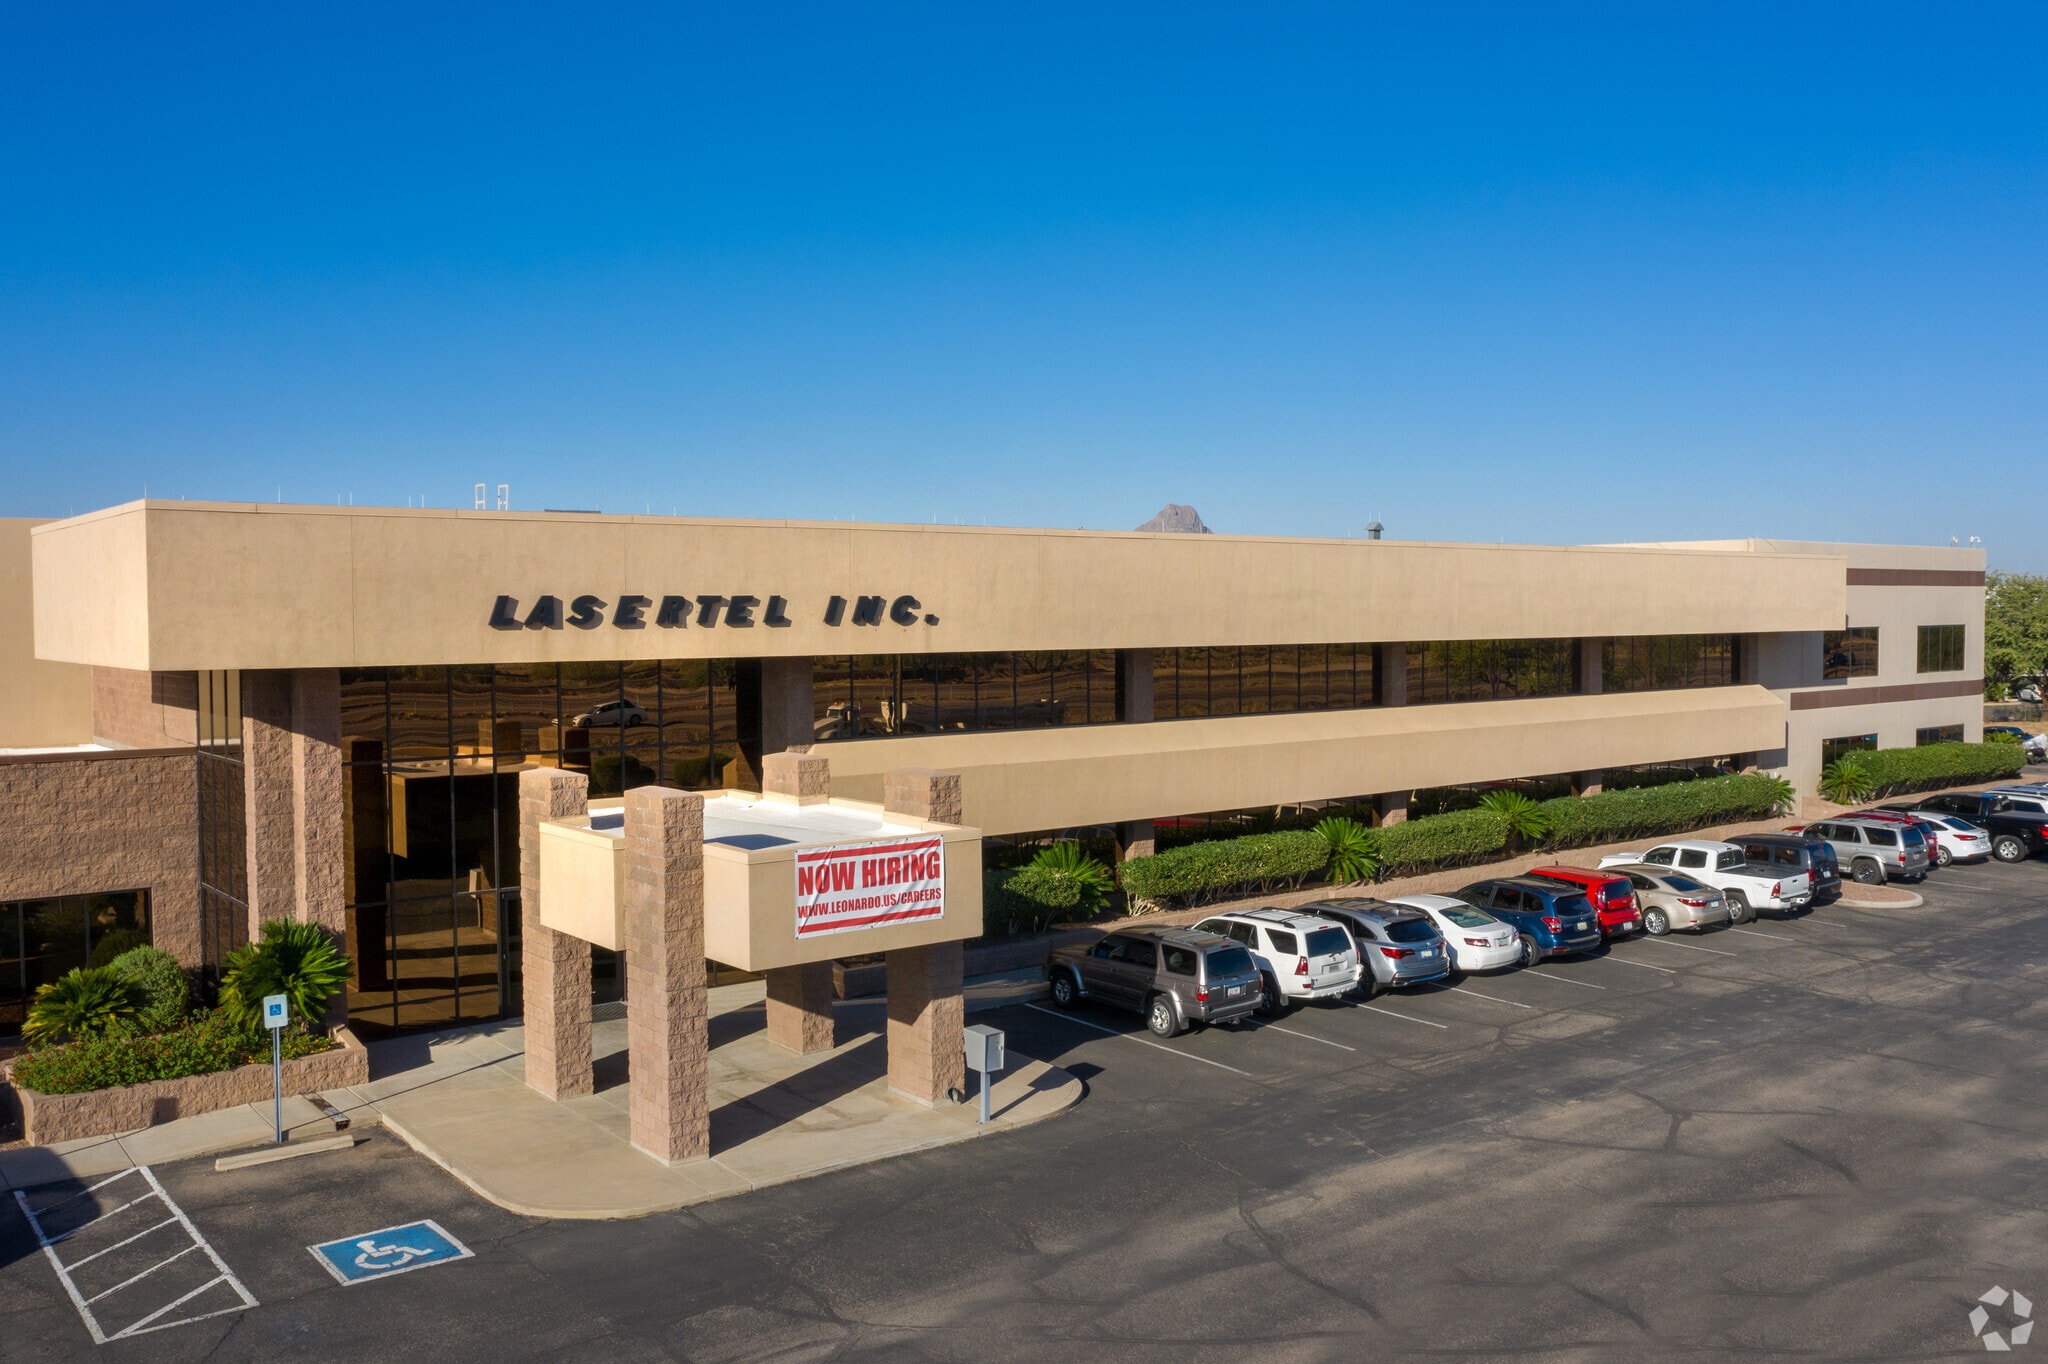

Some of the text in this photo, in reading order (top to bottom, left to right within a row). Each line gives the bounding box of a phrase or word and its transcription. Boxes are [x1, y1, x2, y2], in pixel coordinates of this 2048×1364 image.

[488, 594, 940, 631] LASERTEL INC.
[798, 850, 941, 897] NOW HIRING
[797, 887, 942, 919] WWW.LEONARDO.US/CAREERS
